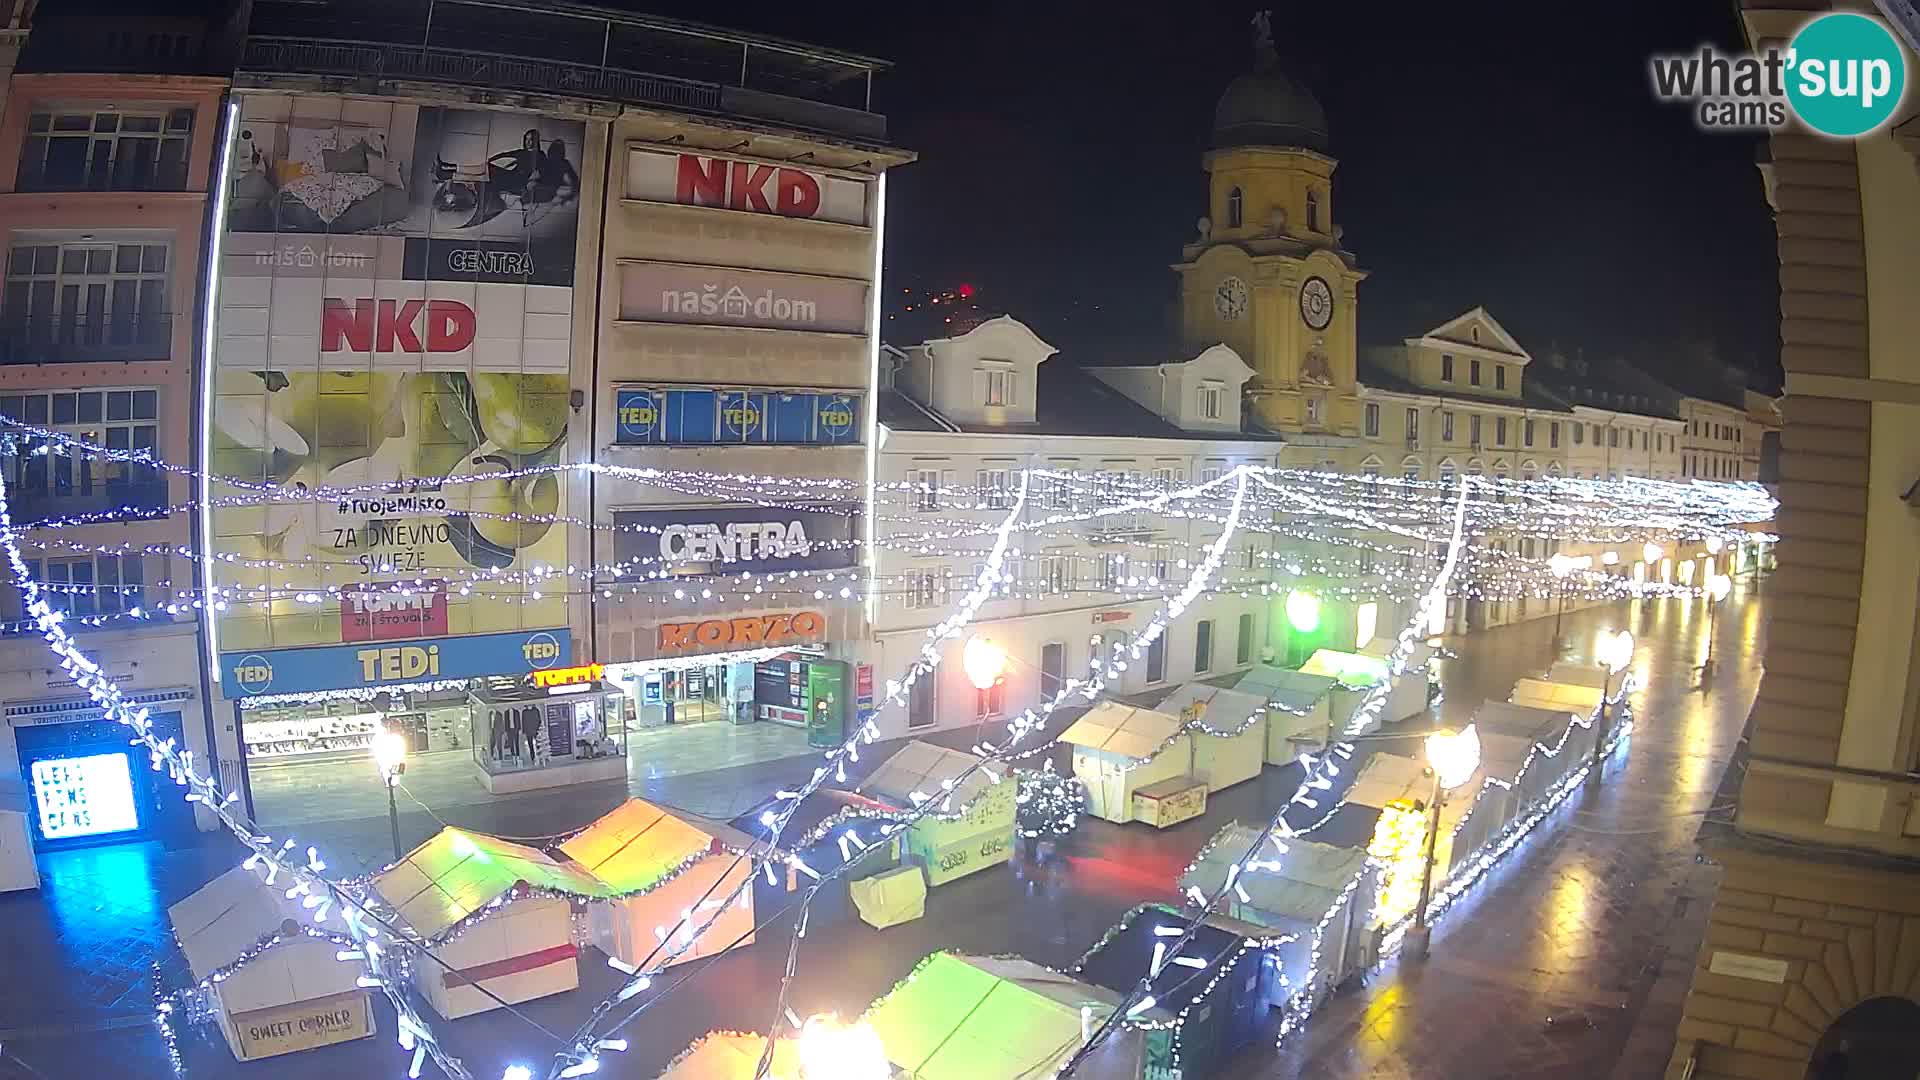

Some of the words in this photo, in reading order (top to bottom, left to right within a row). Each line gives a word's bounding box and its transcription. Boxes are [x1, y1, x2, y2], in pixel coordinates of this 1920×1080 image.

[676, 154, 821, 218] NKD
[448, 249, 535, 276] CENTRA
[661, 283, 719, 316] naš
[754, 290, 817, 322] dom
[321, 297, 477, 353] NKD
[619, 407, 658, 425] TEDi
[723, 409, 760, 426] TEDi
[820, 410, 854, 427] TEDi
[338, 496, 446, 516] #TvojeMisto
[333, 528, 357, 549] ZA
[367, 522, 450, 548] DNEVNO
[659, 520, 811, 562] CENTRA
[359, 546, 426, 575] SVJEŽE
[656, 611, 826, 652] KORZO
[358, 645, 440, 682] TEDi
[522, 643, 560, 661] TEDi
[233, 656, 274, 682] TEDi
[250, 1020, 293, 1042] SWEET
